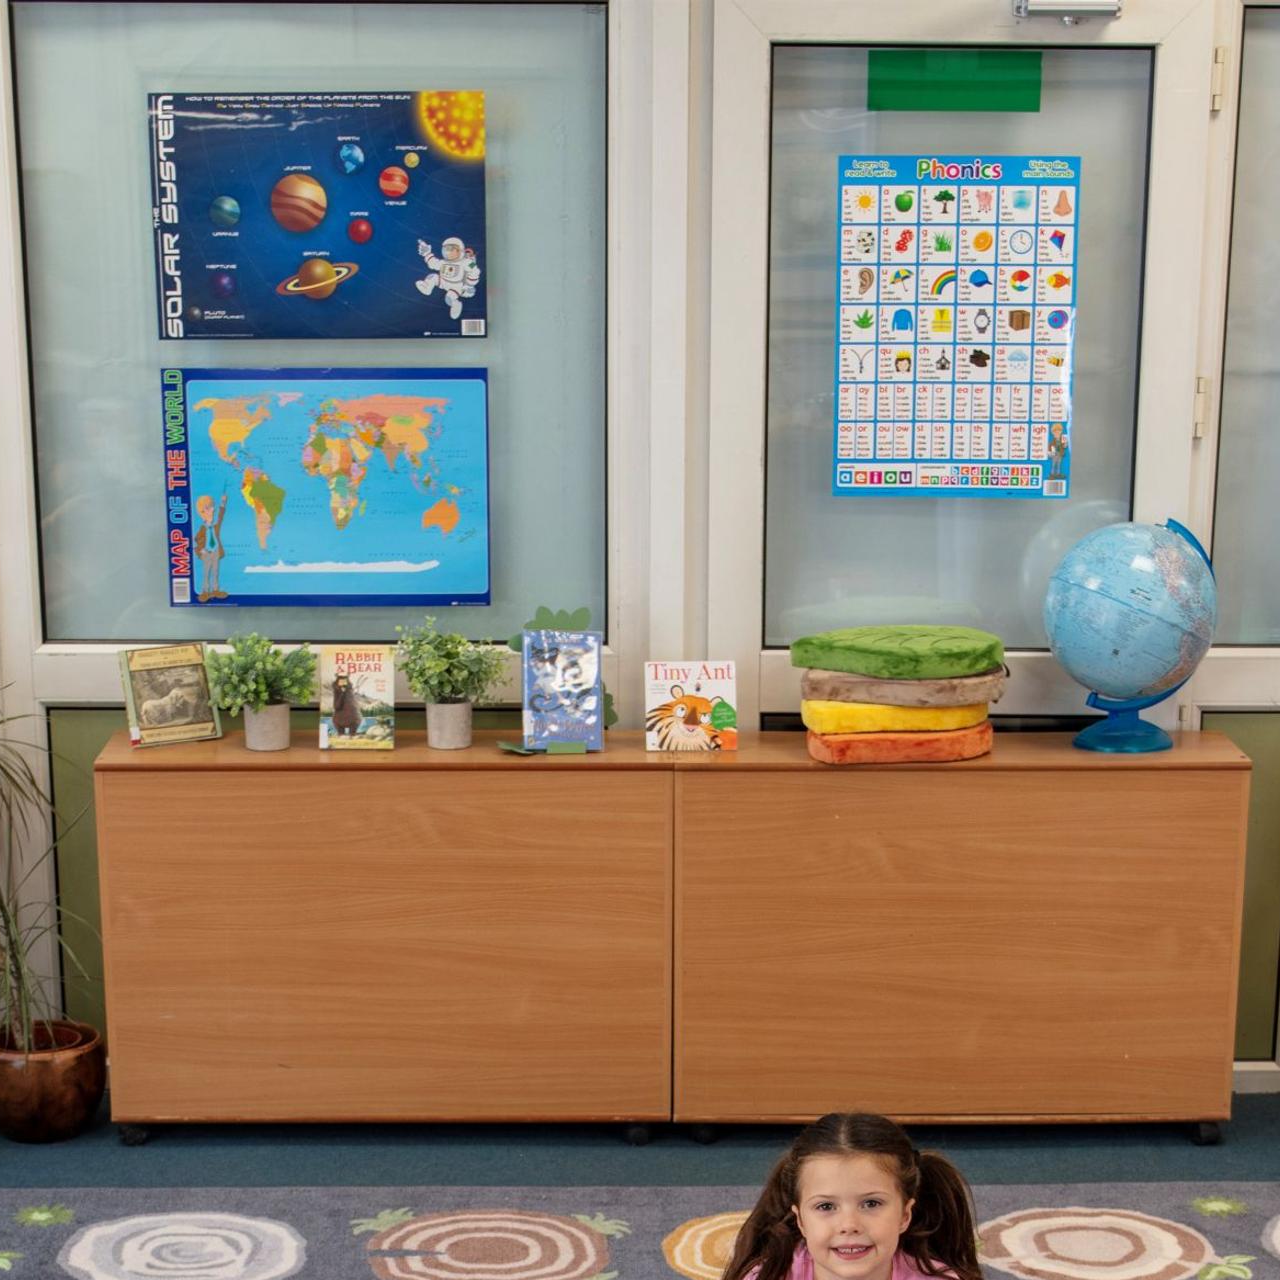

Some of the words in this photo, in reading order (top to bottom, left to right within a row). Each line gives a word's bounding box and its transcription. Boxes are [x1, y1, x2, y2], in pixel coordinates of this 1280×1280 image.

[157, 95, 179, 224] SYSTEM
[916, 158, 1002, 181] Phonics
[153, 208, 161, 228] THE
[163, 232, 184, 338] SOLAR
[163, 369, 185, 446] WORLD
[167, 449, 188, 490] THE
[170, 497, 188, 524] OF
[170, 529, 191, 576] MAP
[335, 652, 384, 665] RABBIT
[347, 662, 382, 674] BEAR
[648, 663, 691, 681] Tiny
[698, 663, 733, 681] Ant
